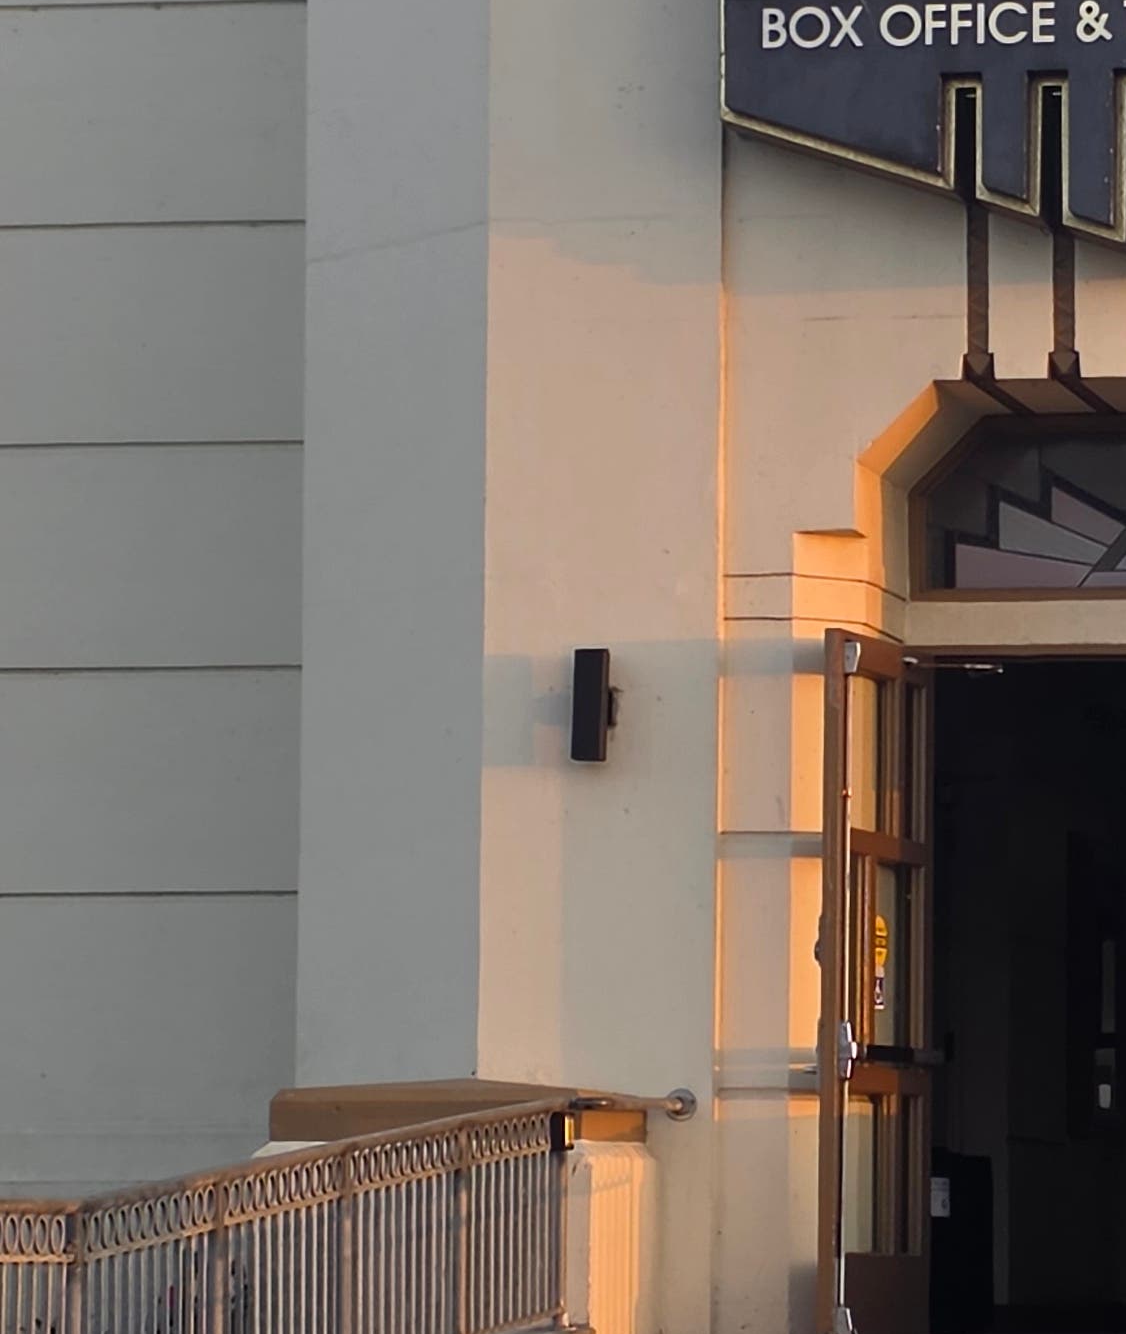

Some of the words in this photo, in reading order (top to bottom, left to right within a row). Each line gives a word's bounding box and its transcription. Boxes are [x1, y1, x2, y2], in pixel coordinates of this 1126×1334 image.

[762, 5, 864, 49] BOX
[880, 0, 1055, 45] OFFICE
[1076, 0, 1113, 43] &
